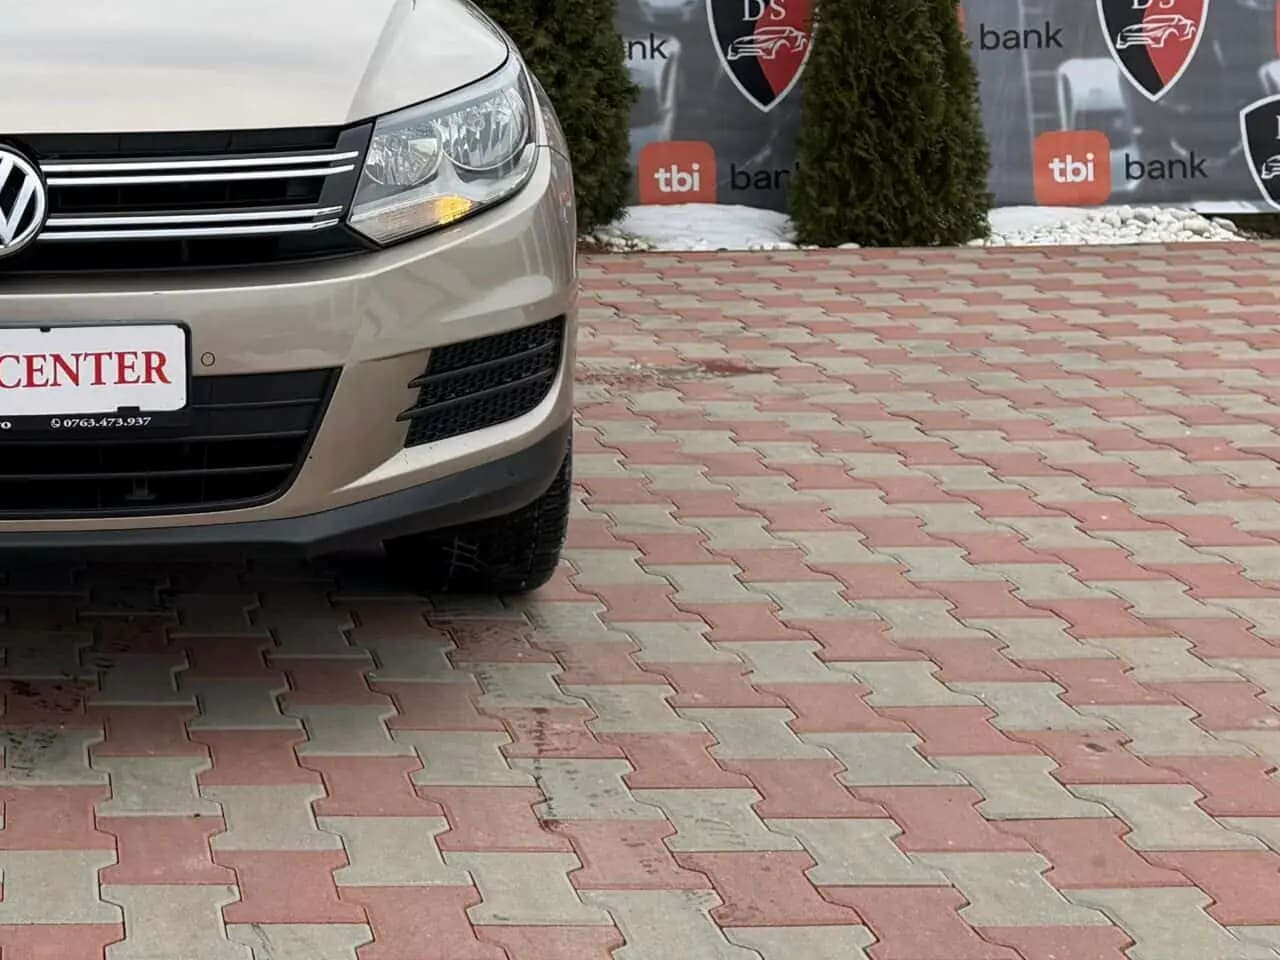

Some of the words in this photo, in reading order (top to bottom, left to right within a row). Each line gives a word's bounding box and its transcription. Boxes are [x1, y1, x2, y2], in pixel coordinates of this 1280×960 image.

[980, 22, 1063, 50] bank
[654, 164, 700, 192] tbi
[1049, 153, 1096, 183] tbi
[1125, 152, 1208, 180] bank
[63, 416, 152, 428] 0763.473.937
